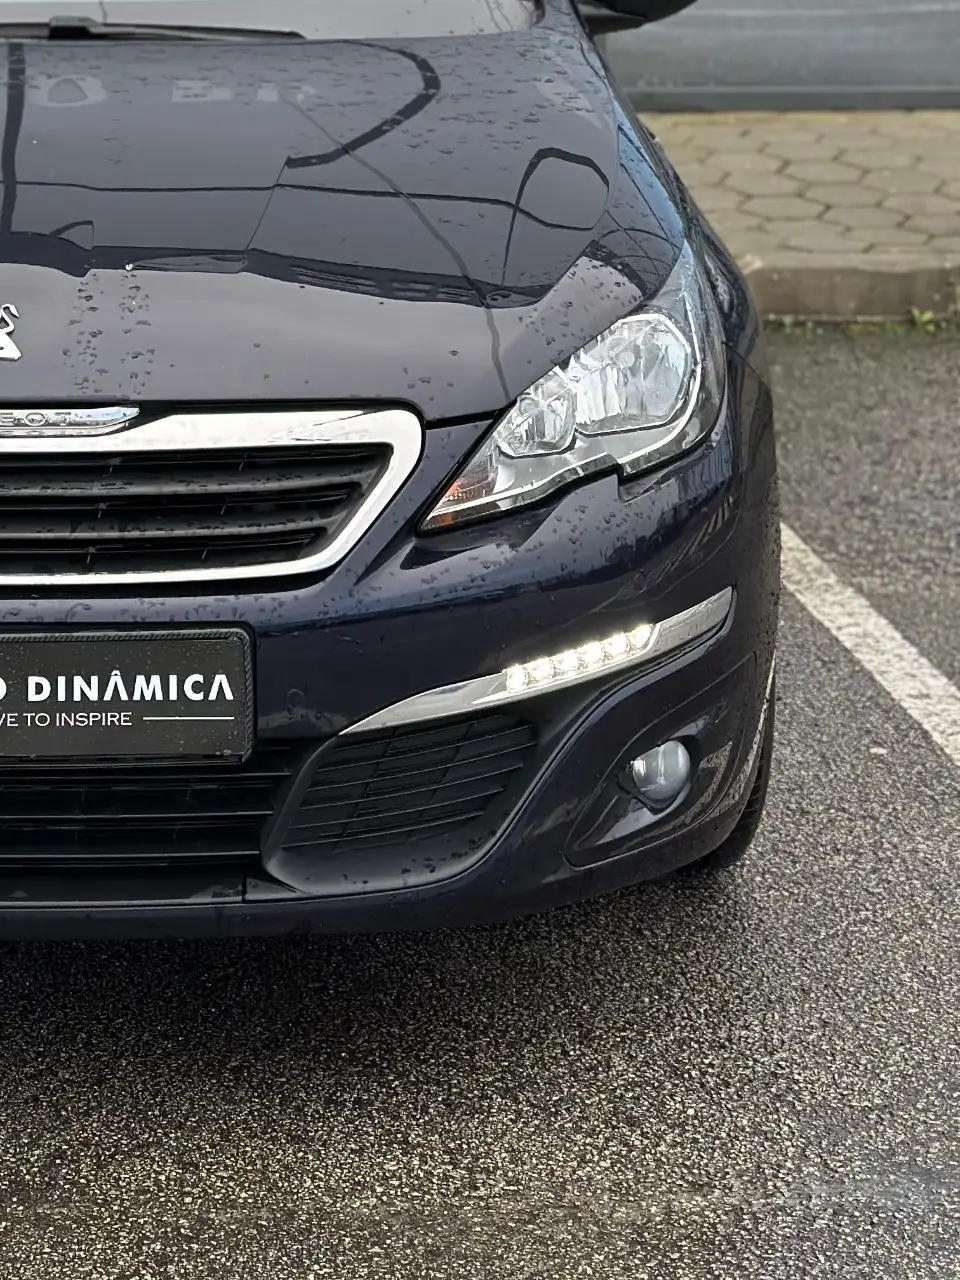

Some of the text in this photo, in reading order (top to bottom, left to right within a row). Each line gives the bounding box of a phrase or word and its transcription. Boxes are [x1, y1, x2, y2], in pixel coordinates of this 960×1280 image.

[27, 670, 234, 702] DINÂMICA
[23, 713, 50, 727] TO
[56, 712, 133, 727] INSPIRE
